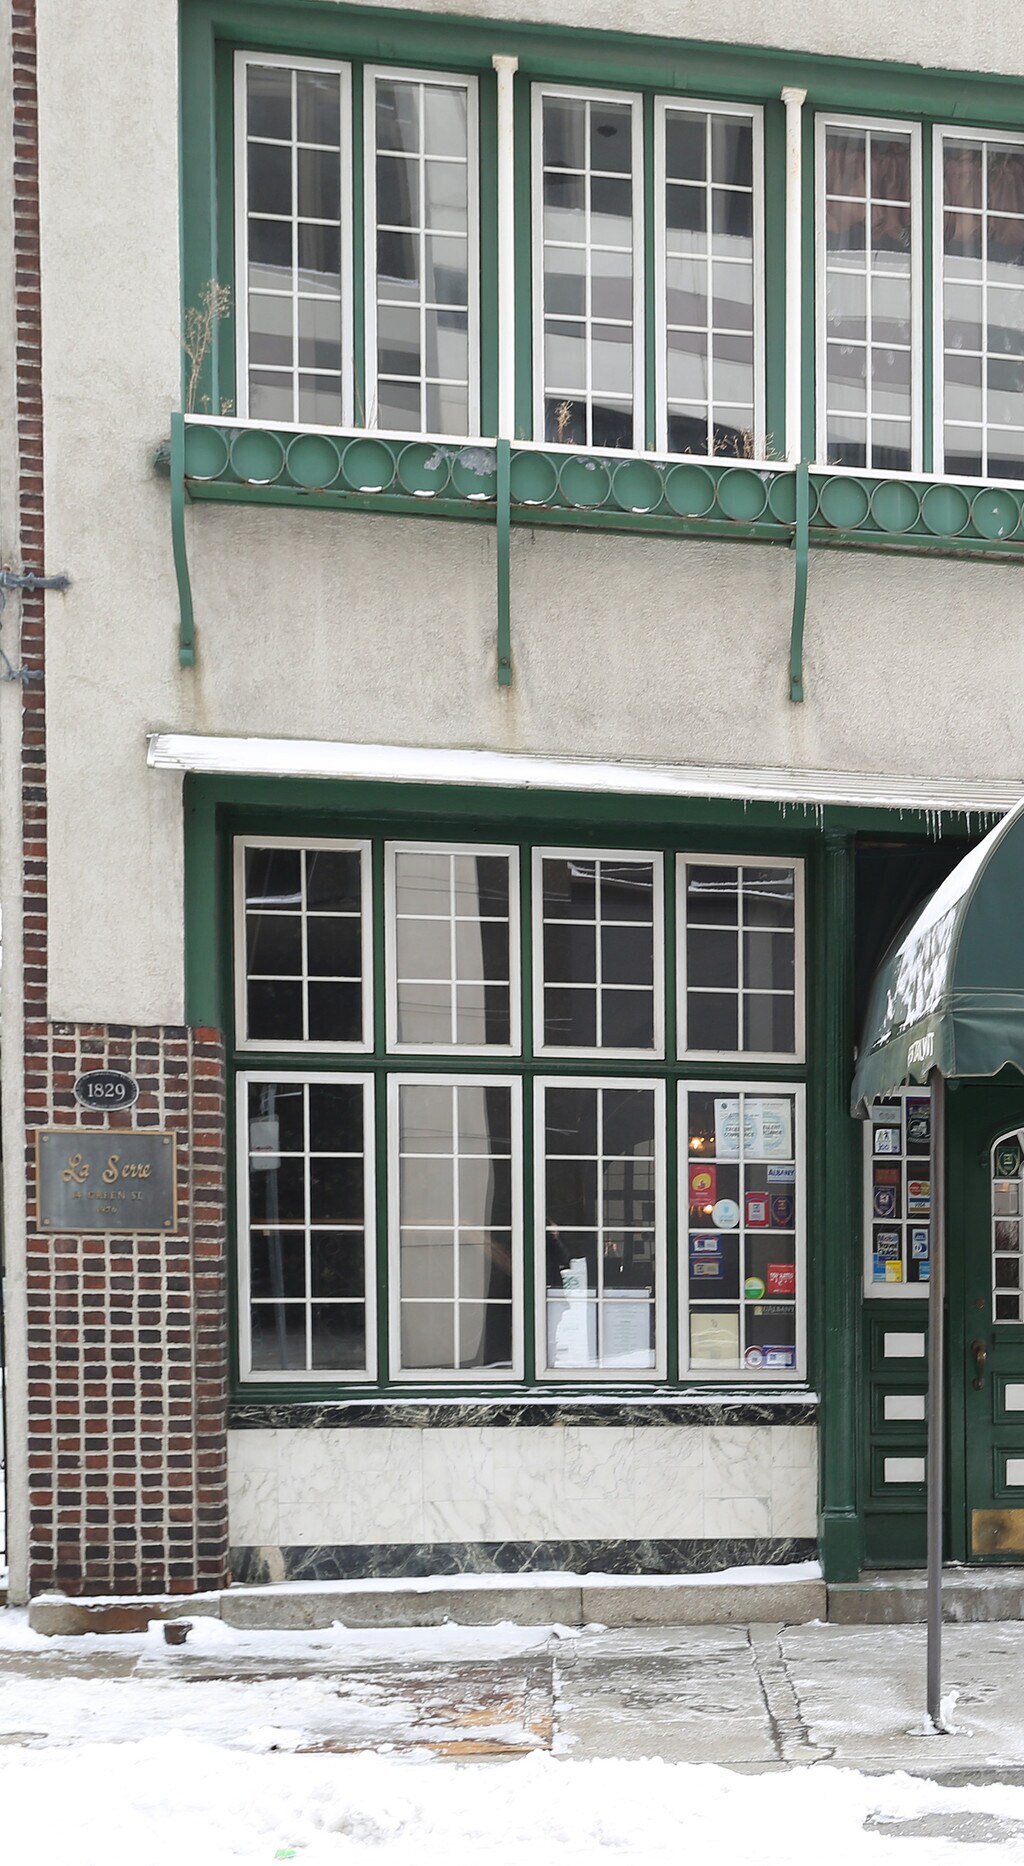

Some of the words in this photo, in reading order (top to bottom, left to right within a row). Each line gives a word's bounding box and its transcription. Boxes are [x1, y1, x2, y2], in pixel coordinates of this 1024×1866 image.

[88, 1083, 126, 1101] 1829
[62, 1153, 90, 1184] La
[102, 1154, 153, 1184] Serre
[88, 1191, 126, 1200] GREEN
